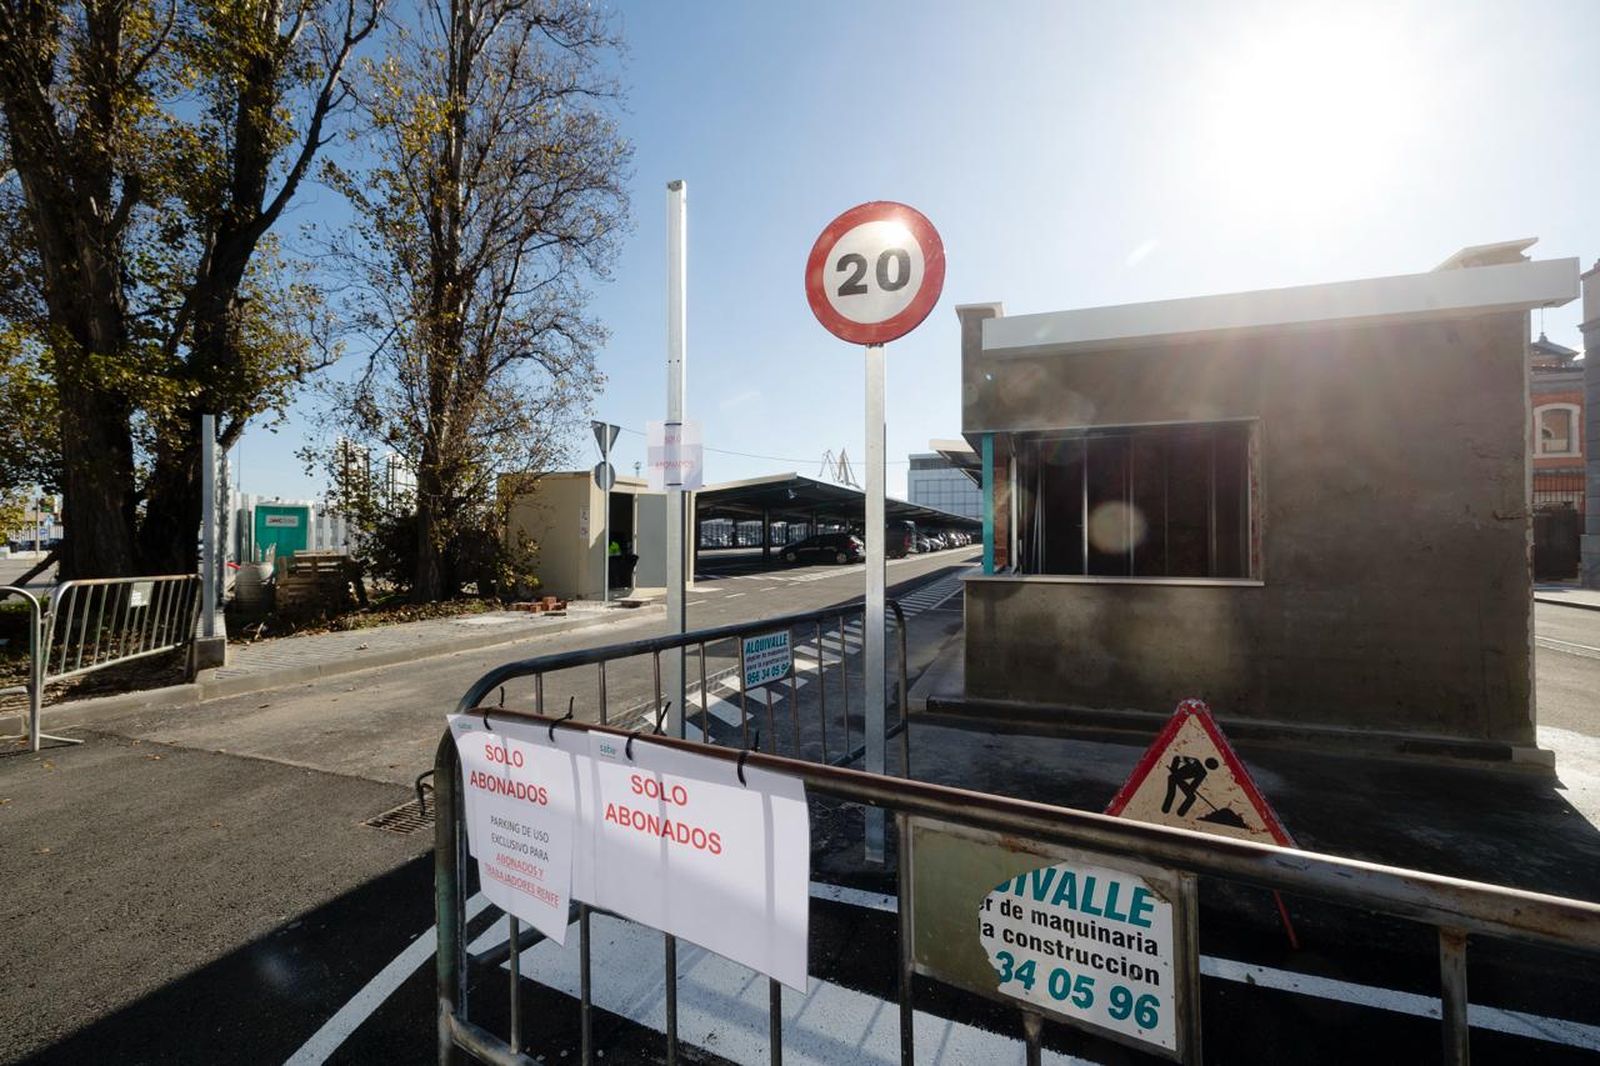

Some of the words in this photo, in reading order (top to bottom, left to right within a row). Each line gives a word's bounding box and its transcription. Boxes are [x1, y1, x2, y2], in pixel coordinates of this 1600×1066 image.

[836, 248, 911, 297] 20
[745, 633, 788, 654] ALQUIVALLE
[485, 744, 524, 768] SOLO
[470, 771, 549, 806] ABONADOS
[631, 774, 688, 806] SOLO
[490, 815, 520, 835] PARKING
[521, 825, 532, 838] DE
[533, 829, 550, 844] USO
[605, 803, 722, 855] ABONADOS
[491, 832, 529, 855] EXCLUSIVO
[529, 846, 549, 862] PARA
[1000, 899, 1023, 920] de
[1031, 907, 1159, 957] maquinaria
[1002, 927, 1160, 986] construccion
[996, 950, 1037, 991] 34
[1047, 967, 1096, 1010] 05
[1108, 985, 1161, 1030] 96
